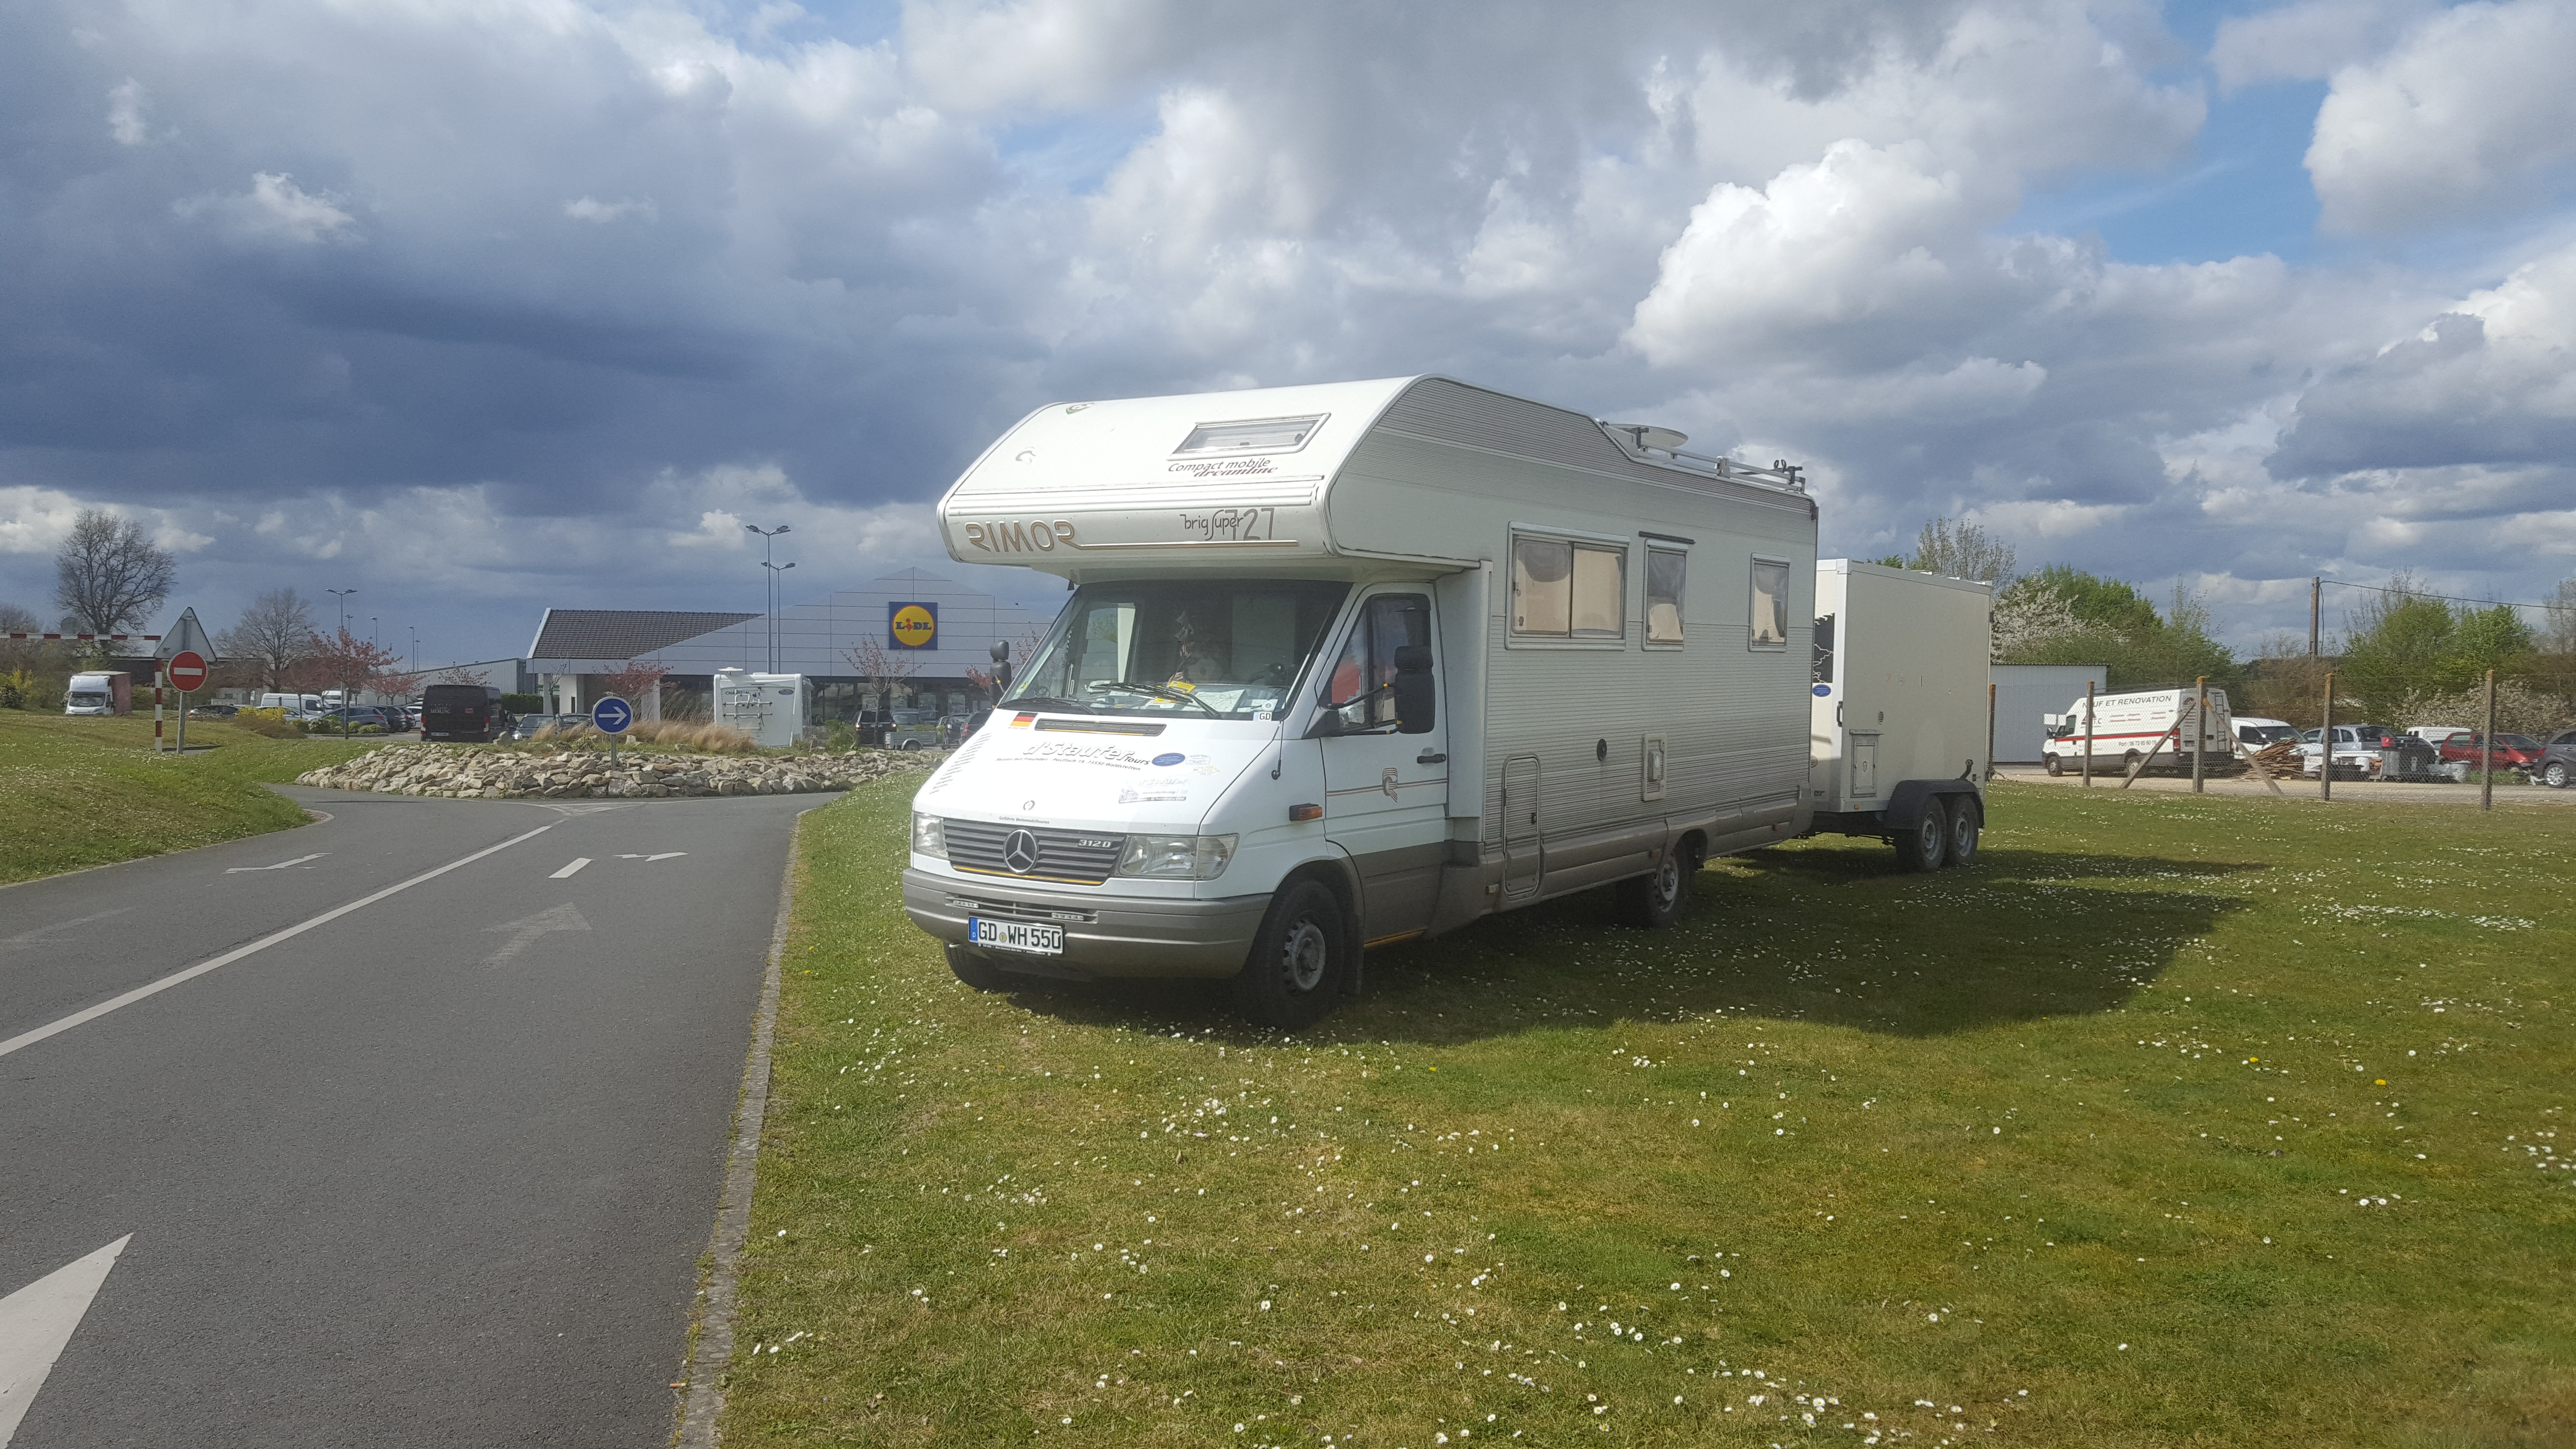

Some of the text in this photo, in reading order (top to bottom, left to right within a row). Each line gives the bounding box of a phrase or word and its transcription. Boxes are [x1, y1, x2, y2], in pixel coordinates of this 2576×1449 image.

[1168, 458, 1271, 473] Compact mobile
[1193, 466, 1278, 477] dreamline
[1179, 514, 1208, 536] brig
[1224, 508, 1275, 541] 727
[965, 519, 1081, 552] RIMOR
[2082, 699, 2103, 708] NUF
[2118, 695, 2172, 705] RENOVATION
[1105, 762, 1141, 771] Waldstetten
[1123, 756, 1151, 765] Tours
[978, 921, 997, 941] GD
[1007, 925, 1028, 946] WH
[1031, 928, 1061, 950] 550
